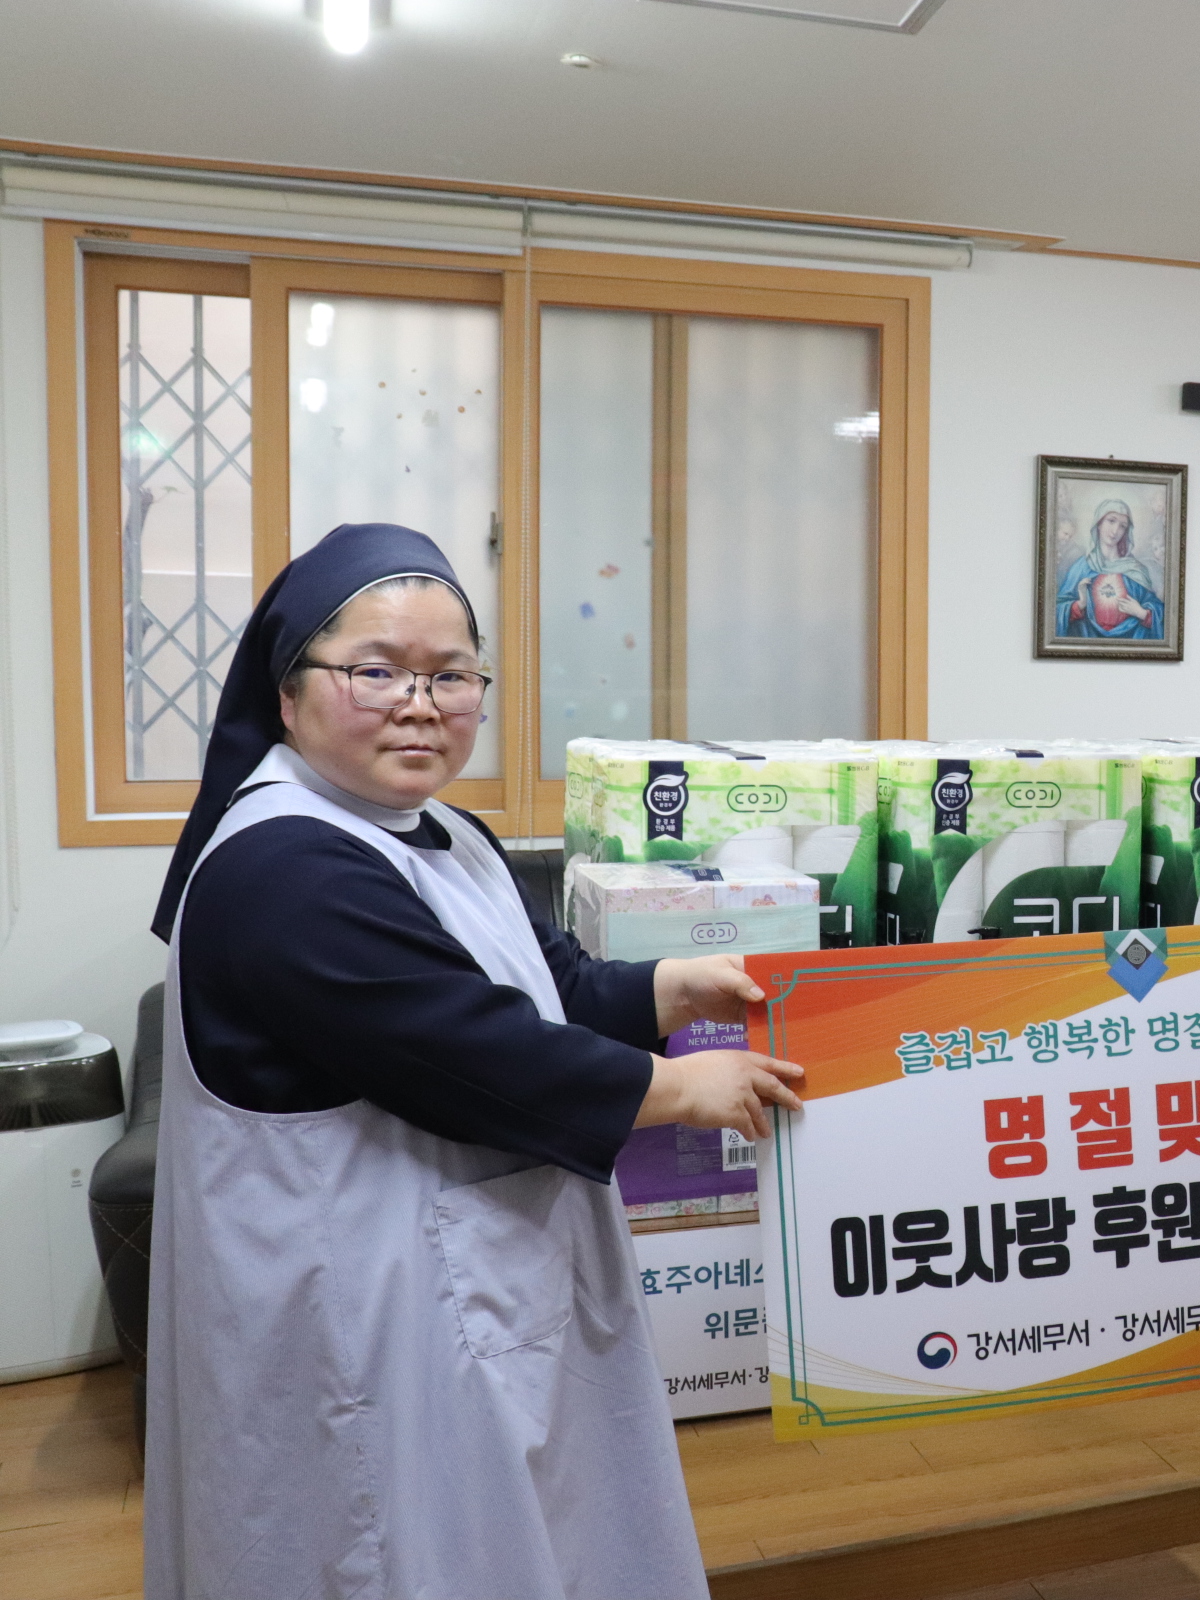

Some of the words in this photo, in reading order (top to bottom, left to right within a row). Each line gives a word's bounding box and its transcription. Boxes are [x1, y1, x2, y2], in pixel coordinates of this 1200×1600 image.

[653, 791, 678, 801] 친환경
[941, 788, 964, 798] 친환경
[688, 1036, 709, 1046] NEW
[710, 1034, 744, 1044] FLOWE
[897, 1029, 1013, 1075] 즐겁고
[1024, 1016, 1136, 1064] 행복한
[830, 1196, 1076, 1298] 이웃사랑
[704, 1307, 767, 1339] 위문
[967, 1319, 1091, 1361] 강서세무서
